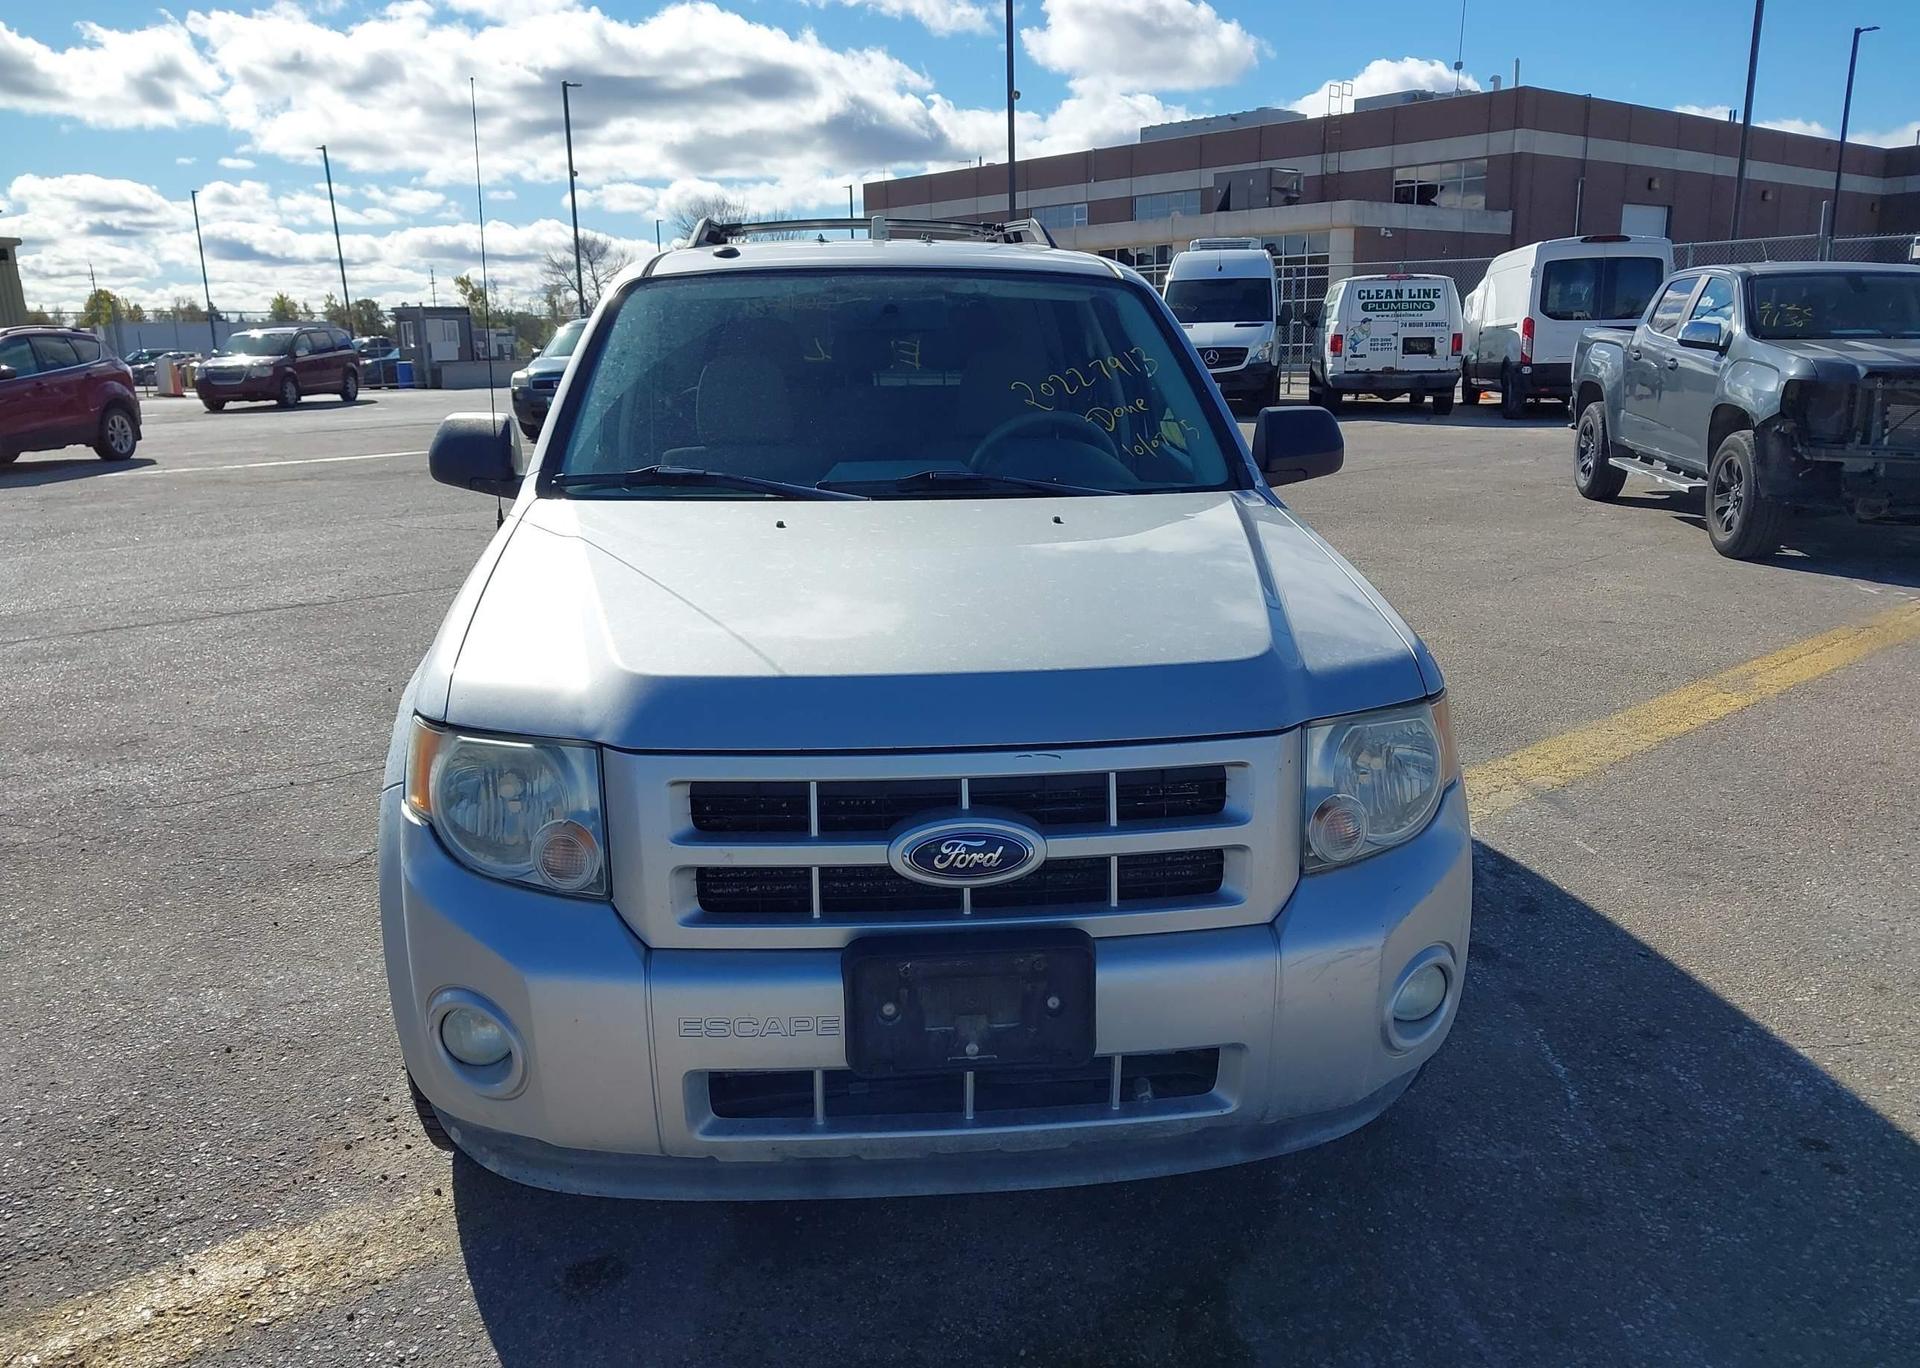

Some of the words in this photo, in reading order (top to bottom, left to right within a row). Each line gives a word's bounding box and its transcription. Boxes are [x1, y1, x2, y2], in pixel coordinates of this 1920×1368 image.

[1357, 288, 1404, 300] CLEAN
[1408, 288, 1441, 299] LINE
[1367, 301, 1431, 311] PLUMBING
[1010, 346, 1158, 411] 20227913
[933, 839, 1004, 870] Ford
[678, 1015, 841, 1038] ESCAPE
